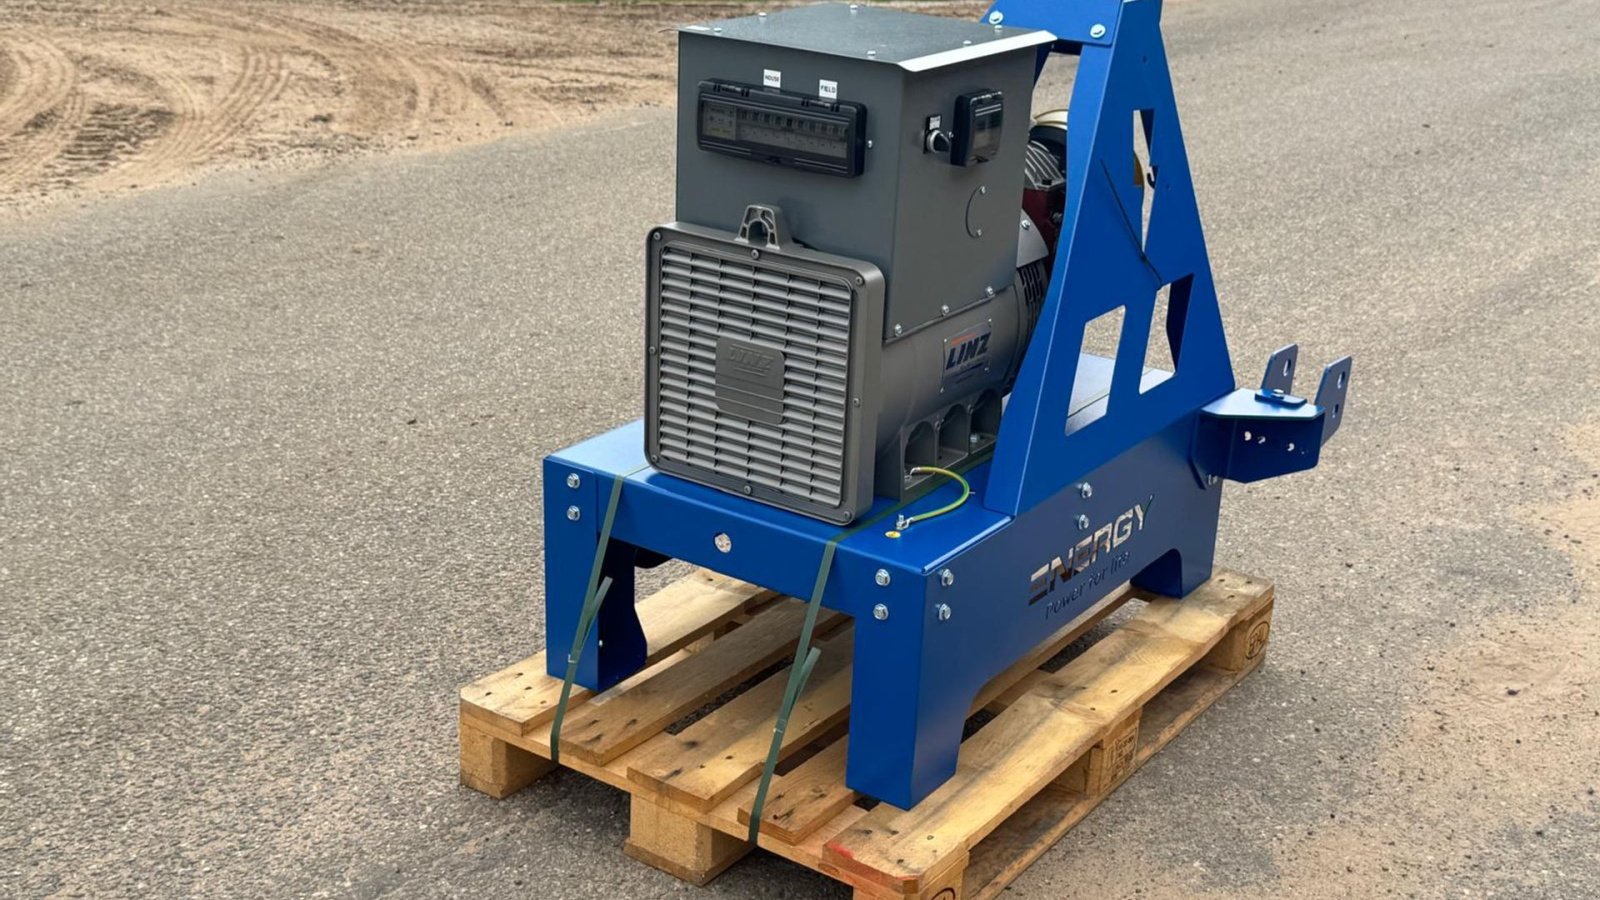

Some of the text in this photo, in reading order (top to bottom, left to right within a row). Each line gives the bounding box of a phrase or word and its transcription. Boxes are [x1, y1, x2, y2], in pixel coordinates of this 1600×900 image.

[764, 74, 780, 82] HOUSE
[820, 85, 836, 93] FIELD
[945, 332, 991, 370] LINZ
[1029, 495, 1154, 605] ENERGY
[1045, 582, 1085, 619] Power
[1089, 566, 1107, 588] for
